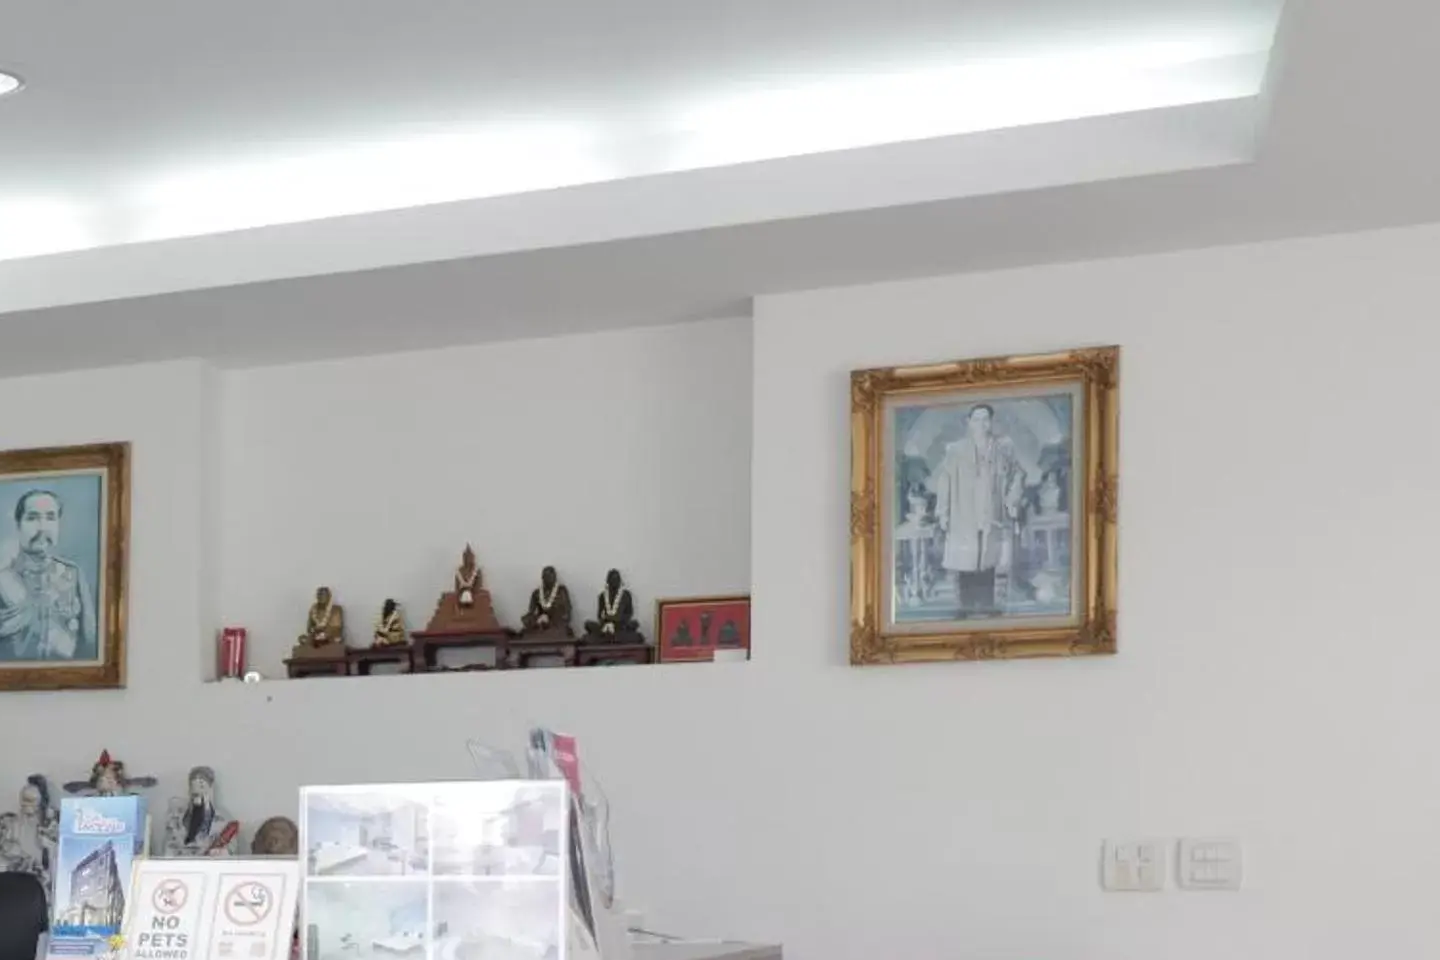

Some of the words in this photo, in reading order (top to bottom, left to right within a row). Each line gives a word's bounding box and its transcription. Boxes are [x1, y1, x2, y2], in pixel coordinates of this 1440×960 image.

[152, 915, 180, 930] NO
[138, 932, 188, 948] PETS
[134, 948, 188, 960] ALLOWED
